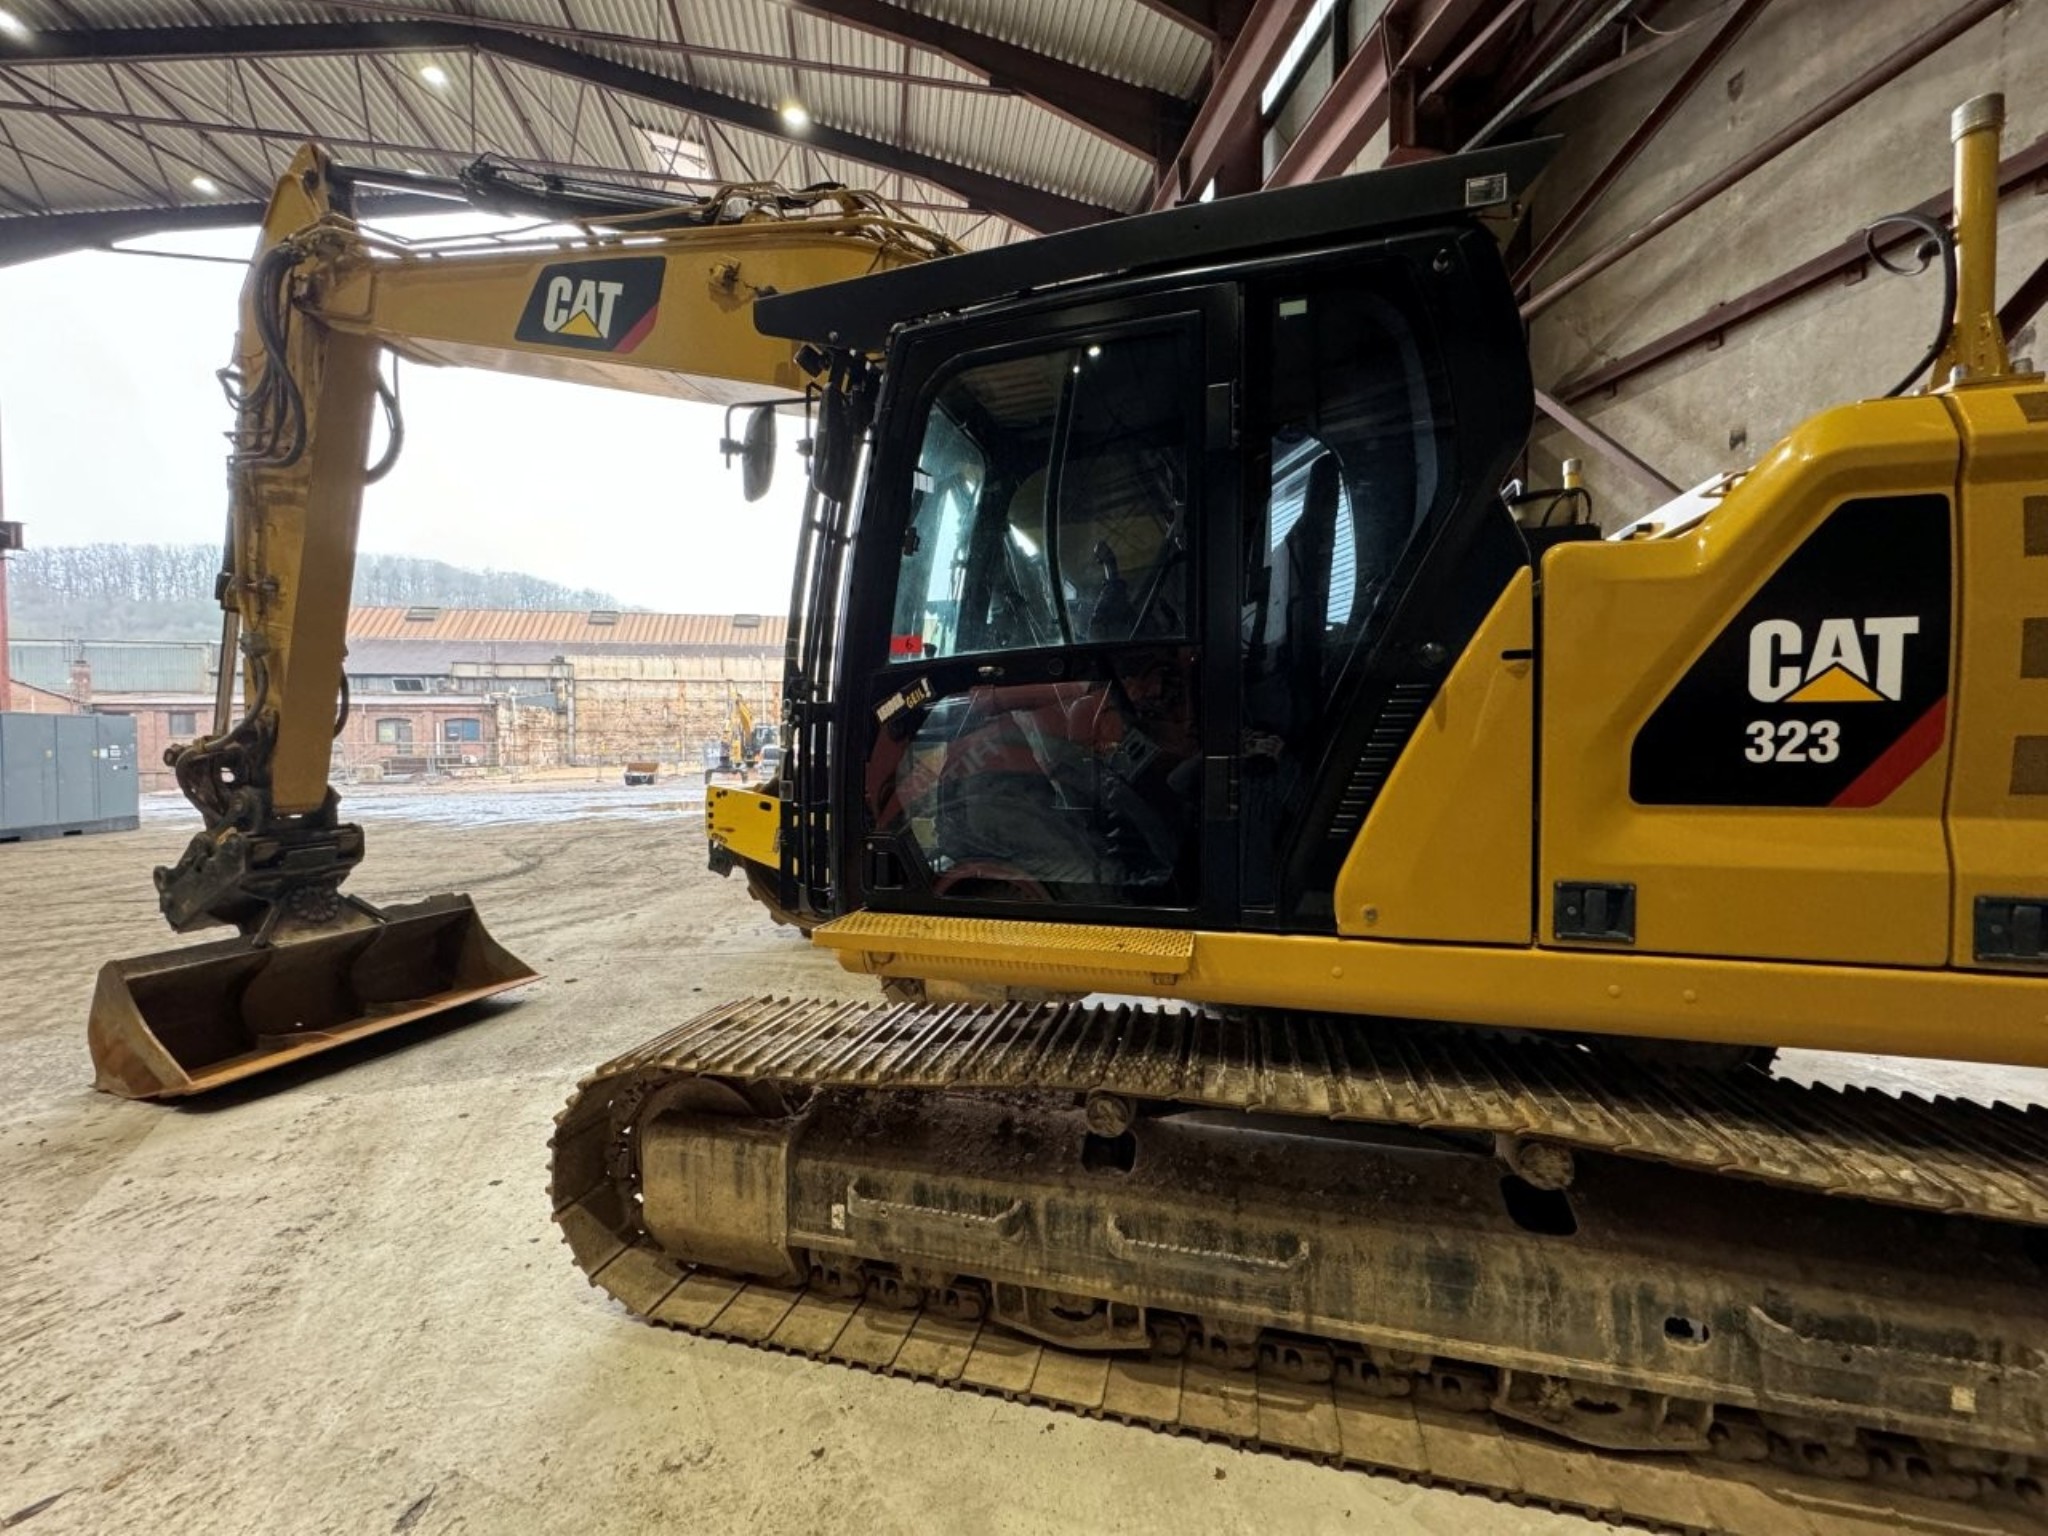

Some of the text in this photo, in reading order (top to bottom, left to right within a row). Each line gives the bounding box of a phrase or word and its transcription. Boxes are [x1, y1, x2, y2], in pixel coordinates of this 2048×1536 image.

[543, 276, 624, 339] CAT
[1748, 616, 1920, 703] CAT
[1745, 720, 1841, 764] 323
